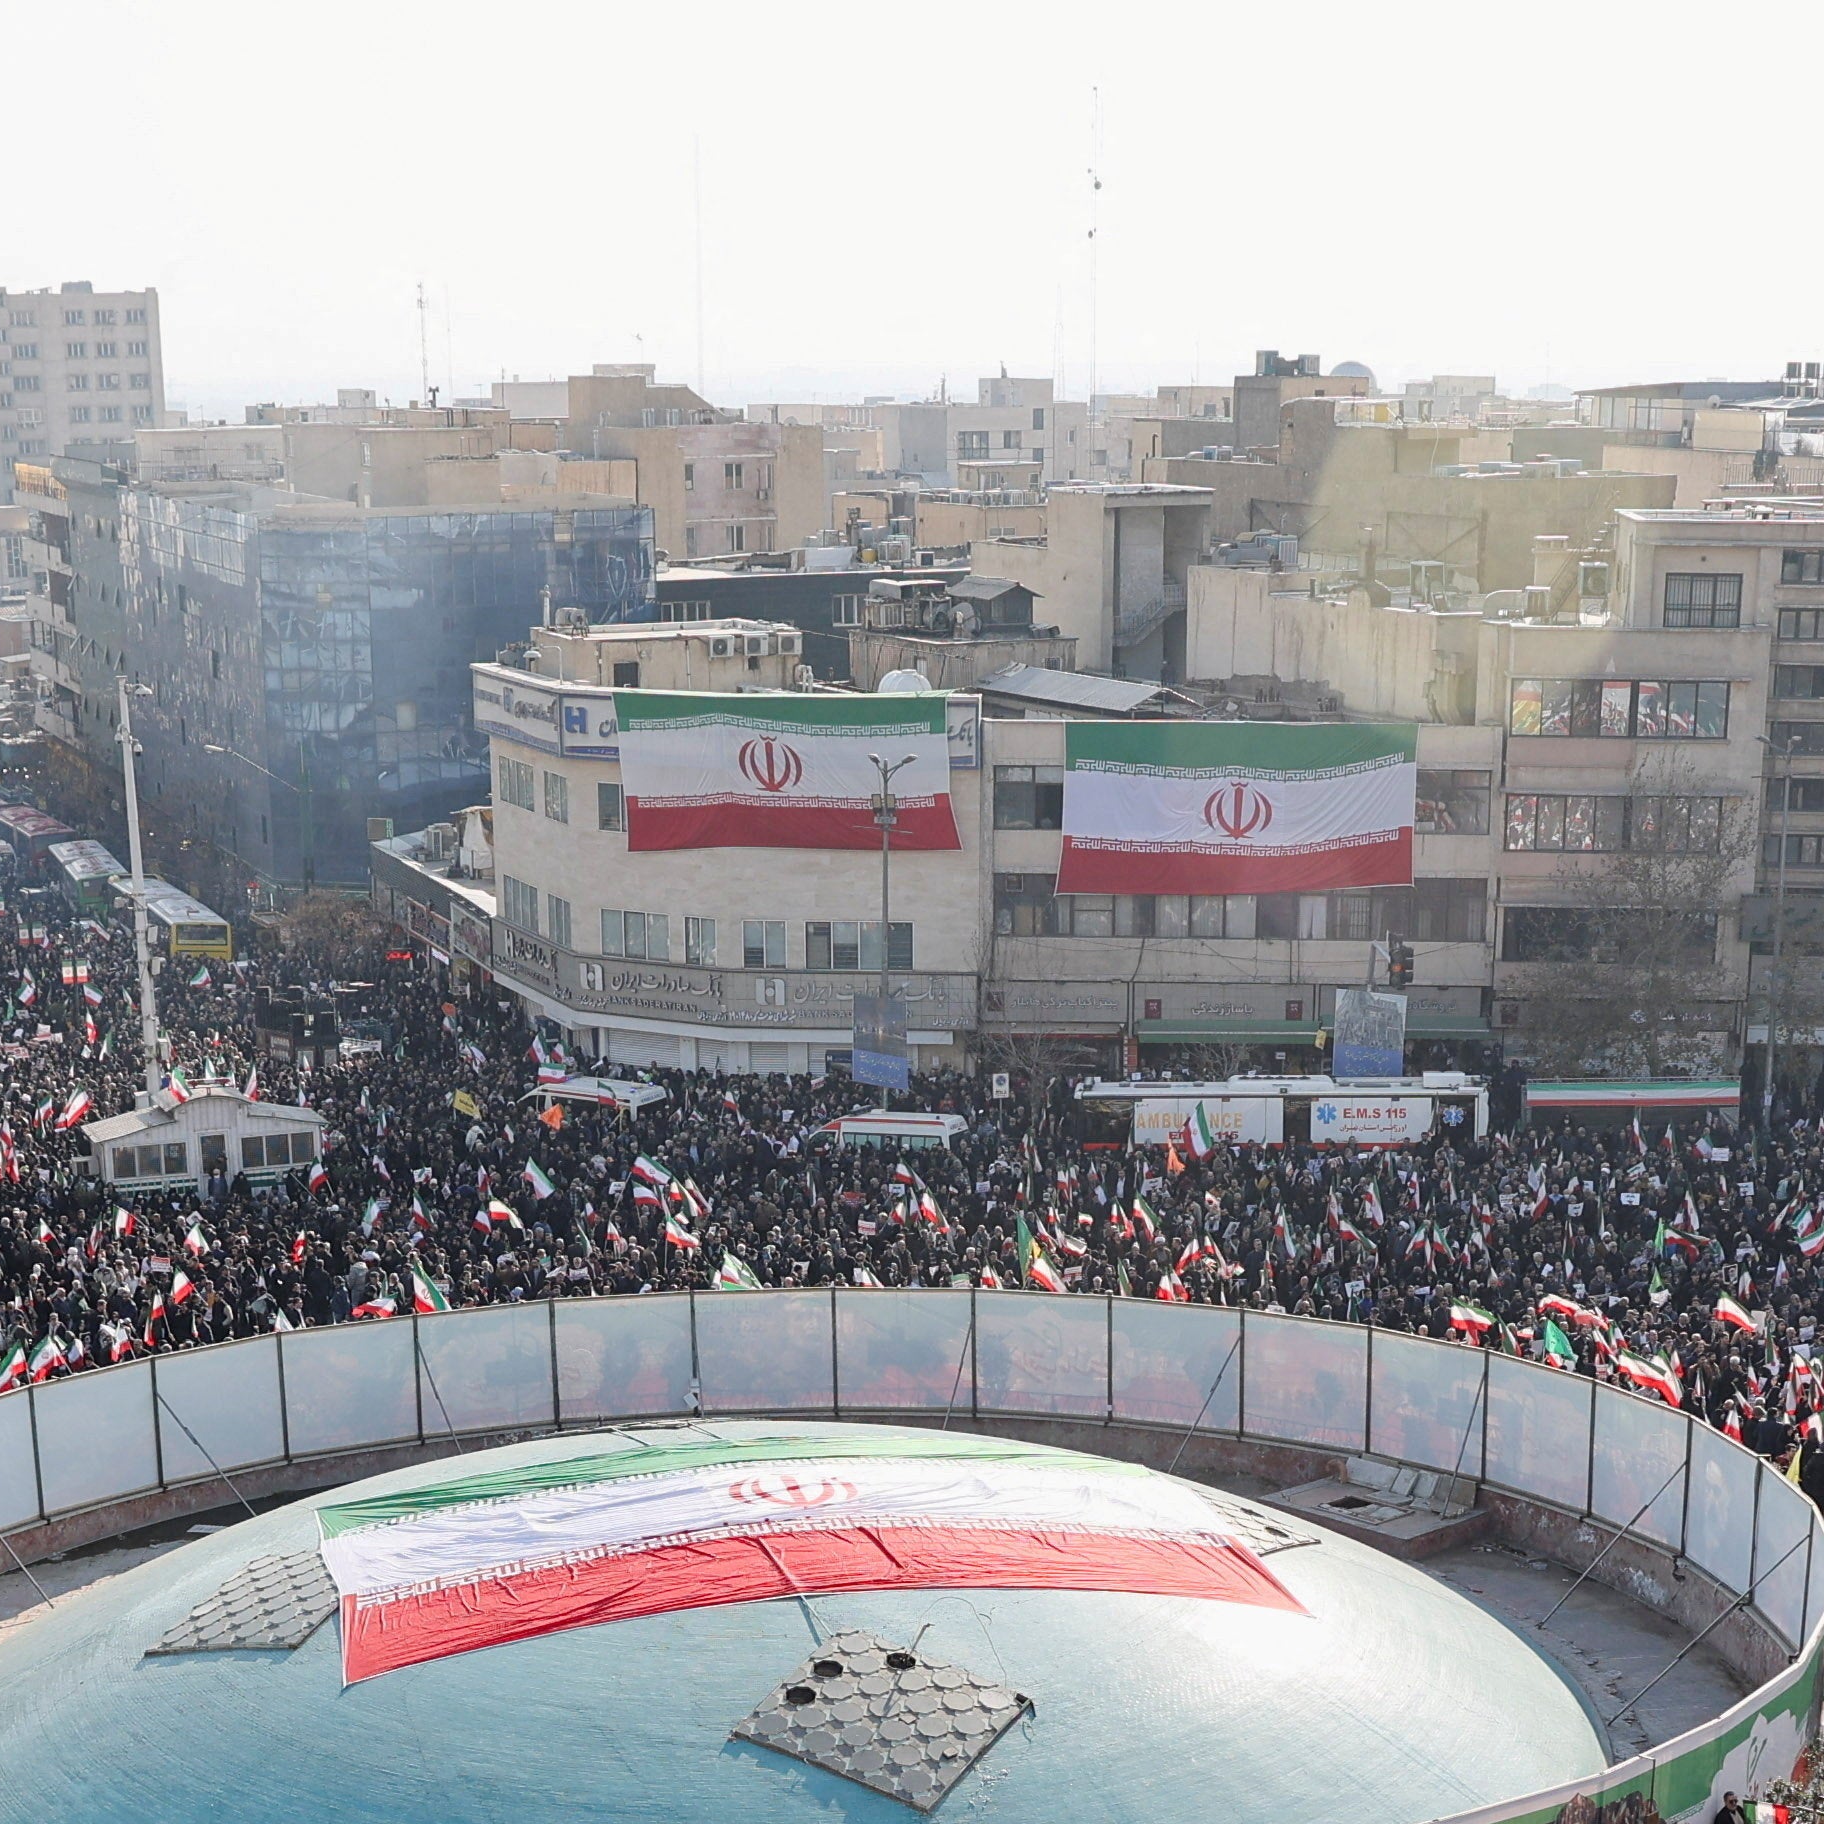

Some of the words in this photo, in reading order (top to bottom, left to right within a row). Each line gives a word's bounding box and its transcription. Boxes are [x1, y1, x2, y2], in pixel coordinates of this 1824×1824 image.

[611, 971, 642, 994] ایران
[642, 973, 690, 992] صادرات
[691, 974, 723, 1004] بانک
[793, 981, 833, 1003] ایران
[905, 976, 945, 1008] بانک
[1191, 1001, 1225, 1015] زندگی
[1136, 1112, 1243, 1129] AMBUNCE
[1343, 1108, 1381, 1119] E.M.S
[1385, 1108, 1407, 1119] 115
